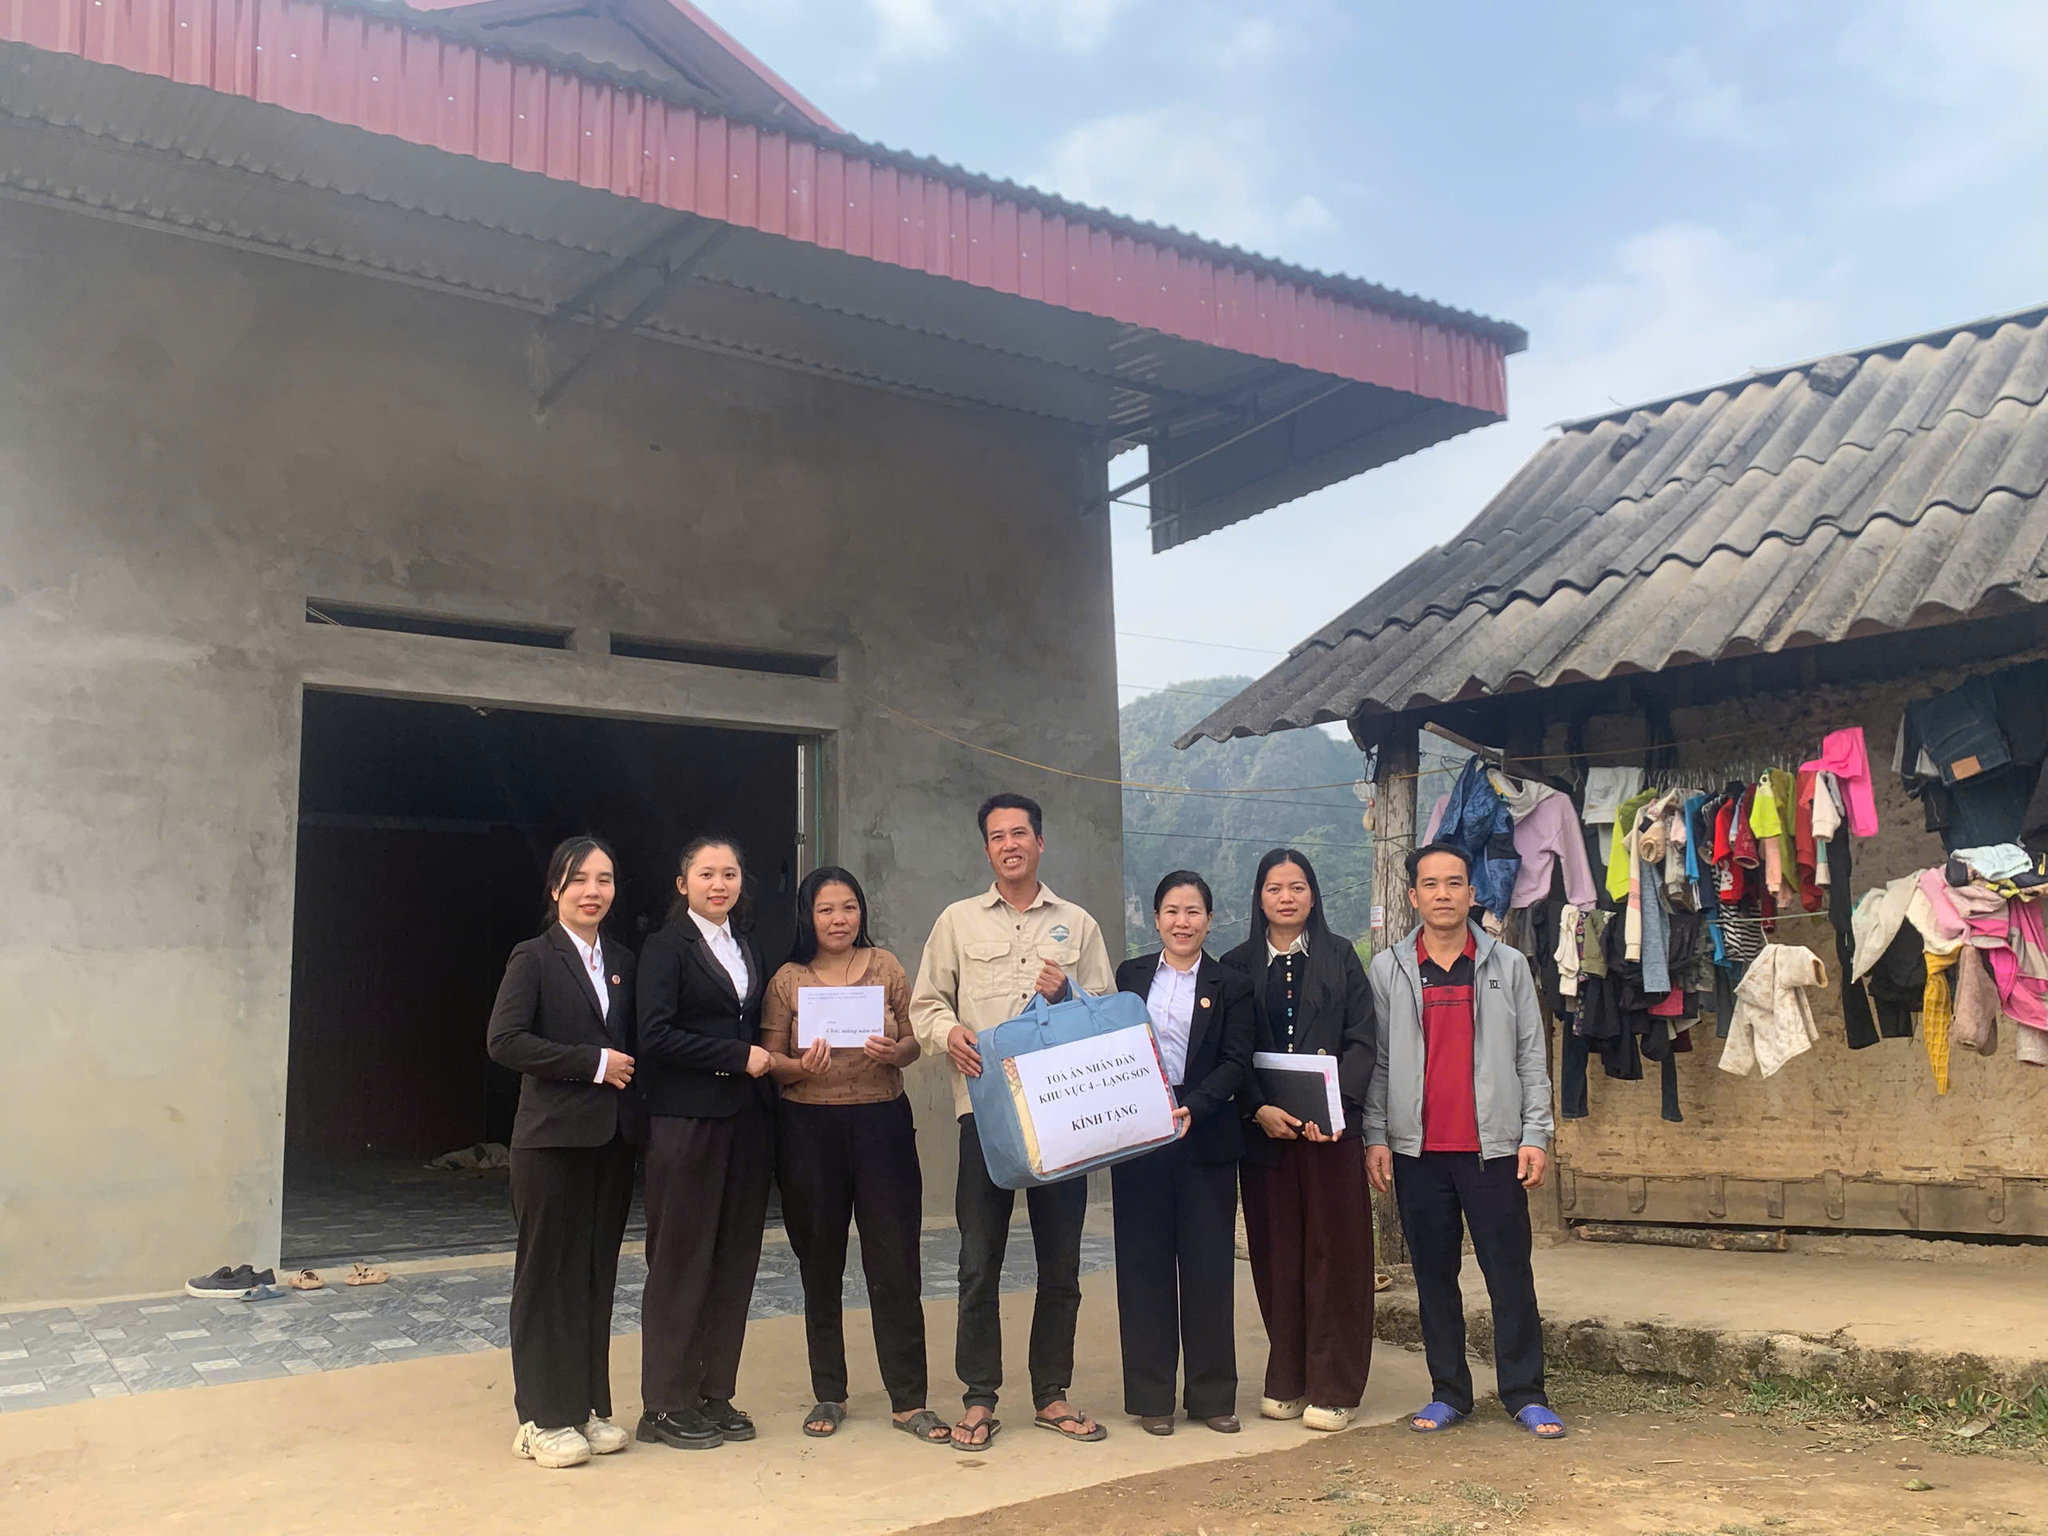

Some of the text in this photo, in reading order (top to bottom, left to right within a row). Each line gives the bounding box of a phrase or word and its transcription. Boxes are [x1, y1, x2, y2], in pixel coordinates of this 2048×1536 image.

[1070, 1066, 1084, 1079] ÁN
[1085, 1058, 1113, 1073] NHÂN
[1115, 1053, 1136, 1067] DÂN
[1039, 1089, 1062, 1104] KHU
[1064, 1083, 1087, 1097] VỰC
[1088, 1081, 1095, 1090] 4
[1102, 1071, 1130, 1087] LẠNG
[1071, 1103, 1138, 1131] KÍNH TẶNG
